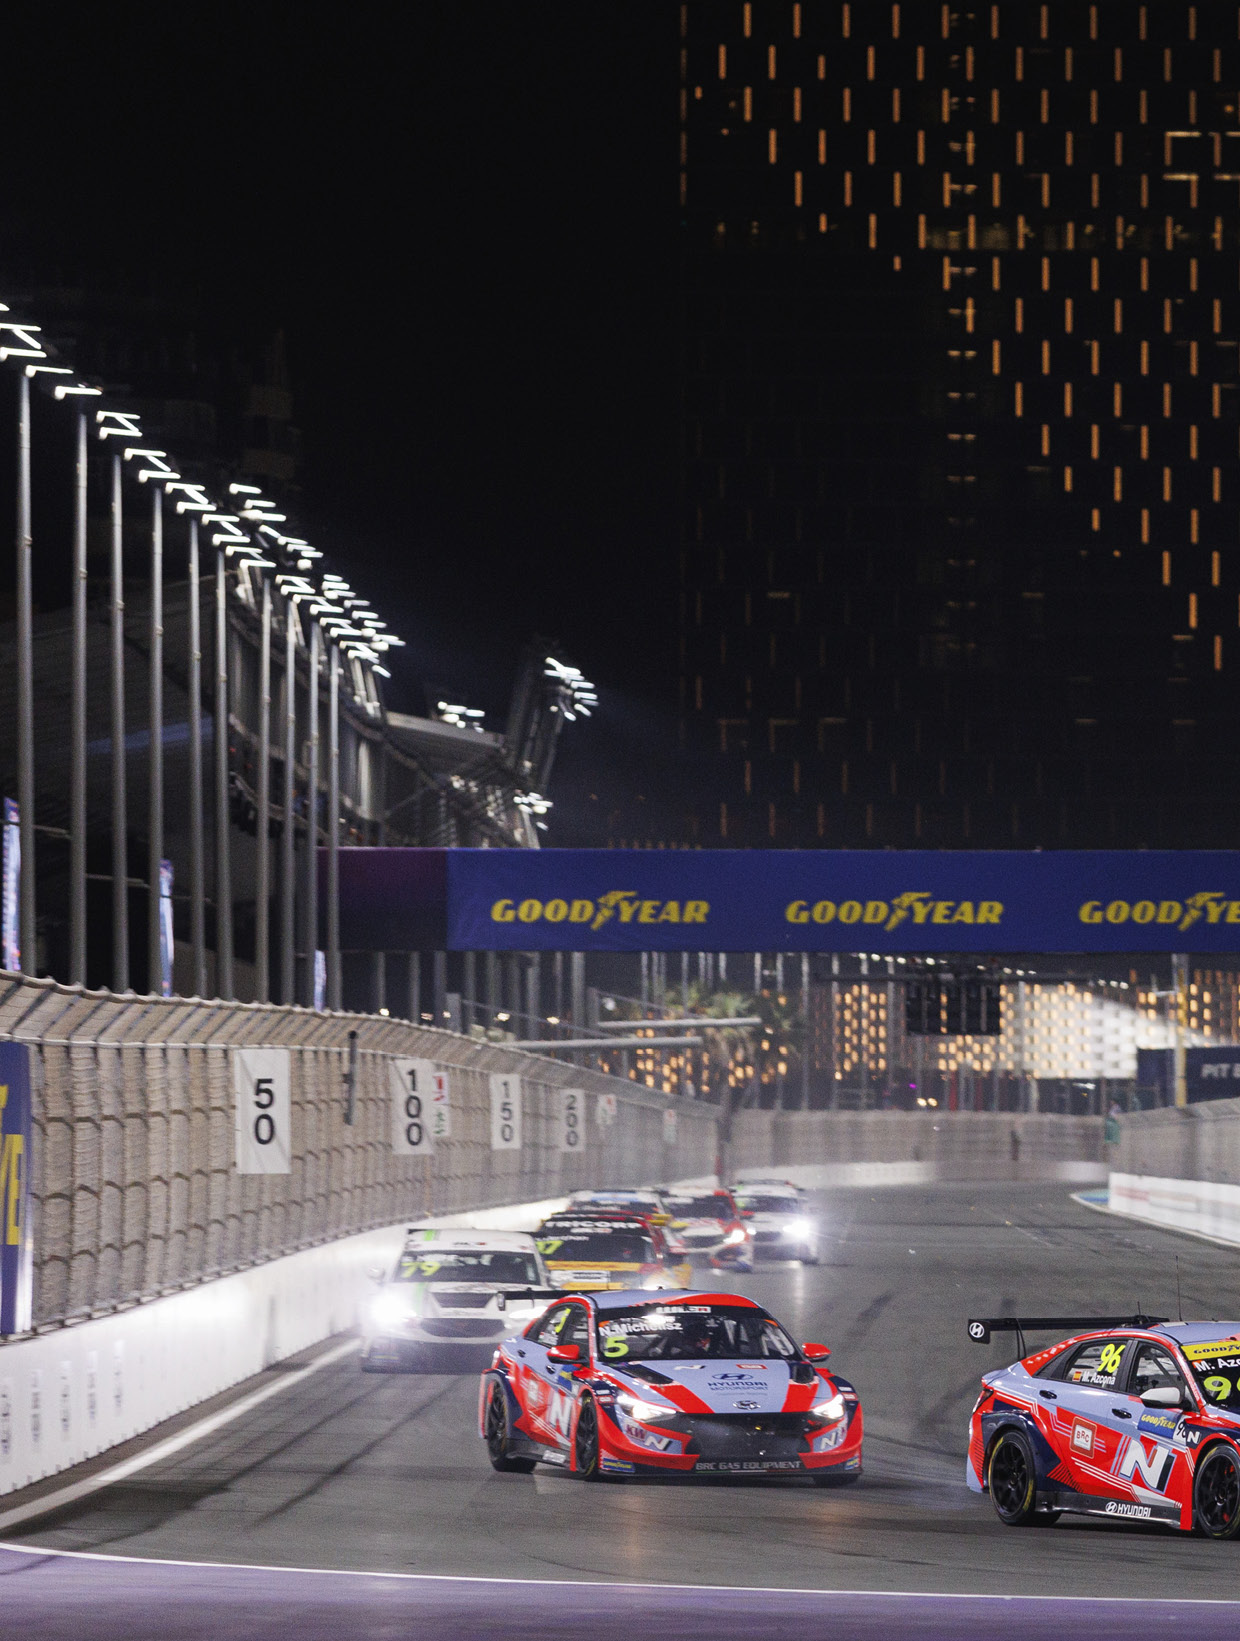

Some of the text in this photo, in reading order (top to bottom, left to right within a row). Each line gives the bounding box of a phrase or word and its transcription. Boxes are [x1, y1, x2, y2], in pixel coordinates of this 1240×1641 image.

[491, 894, 710, 927] GOODYEAR
[785, 895, 1004, 928] GOODYEAR
[1202, 1063, 1230, 1078] PIT
[254, 1078, 275, 1145] 50
[405, 1069, 423, 1146] 100
[500, 1081, 514, 1143] 150
[545, 1221, 642, 1229] TRICORP
[401, 1261, 441, 1279] 79
[603, 1336, 630, 1358] 5
[1097, 1343, 1126, 1374] 96
[1090, 1371, 1116, 1386] Azcona
[1141, 1413, 1176, 1430] GOODYEAR
[1076, 1430, 1090, 1443] BRC
[719, 1462, 741, 1470] GAS
[743, 1460, 801, 1469] EQUIPMENT
[1117, 1504, 1152, 1518] HYUNDAI
